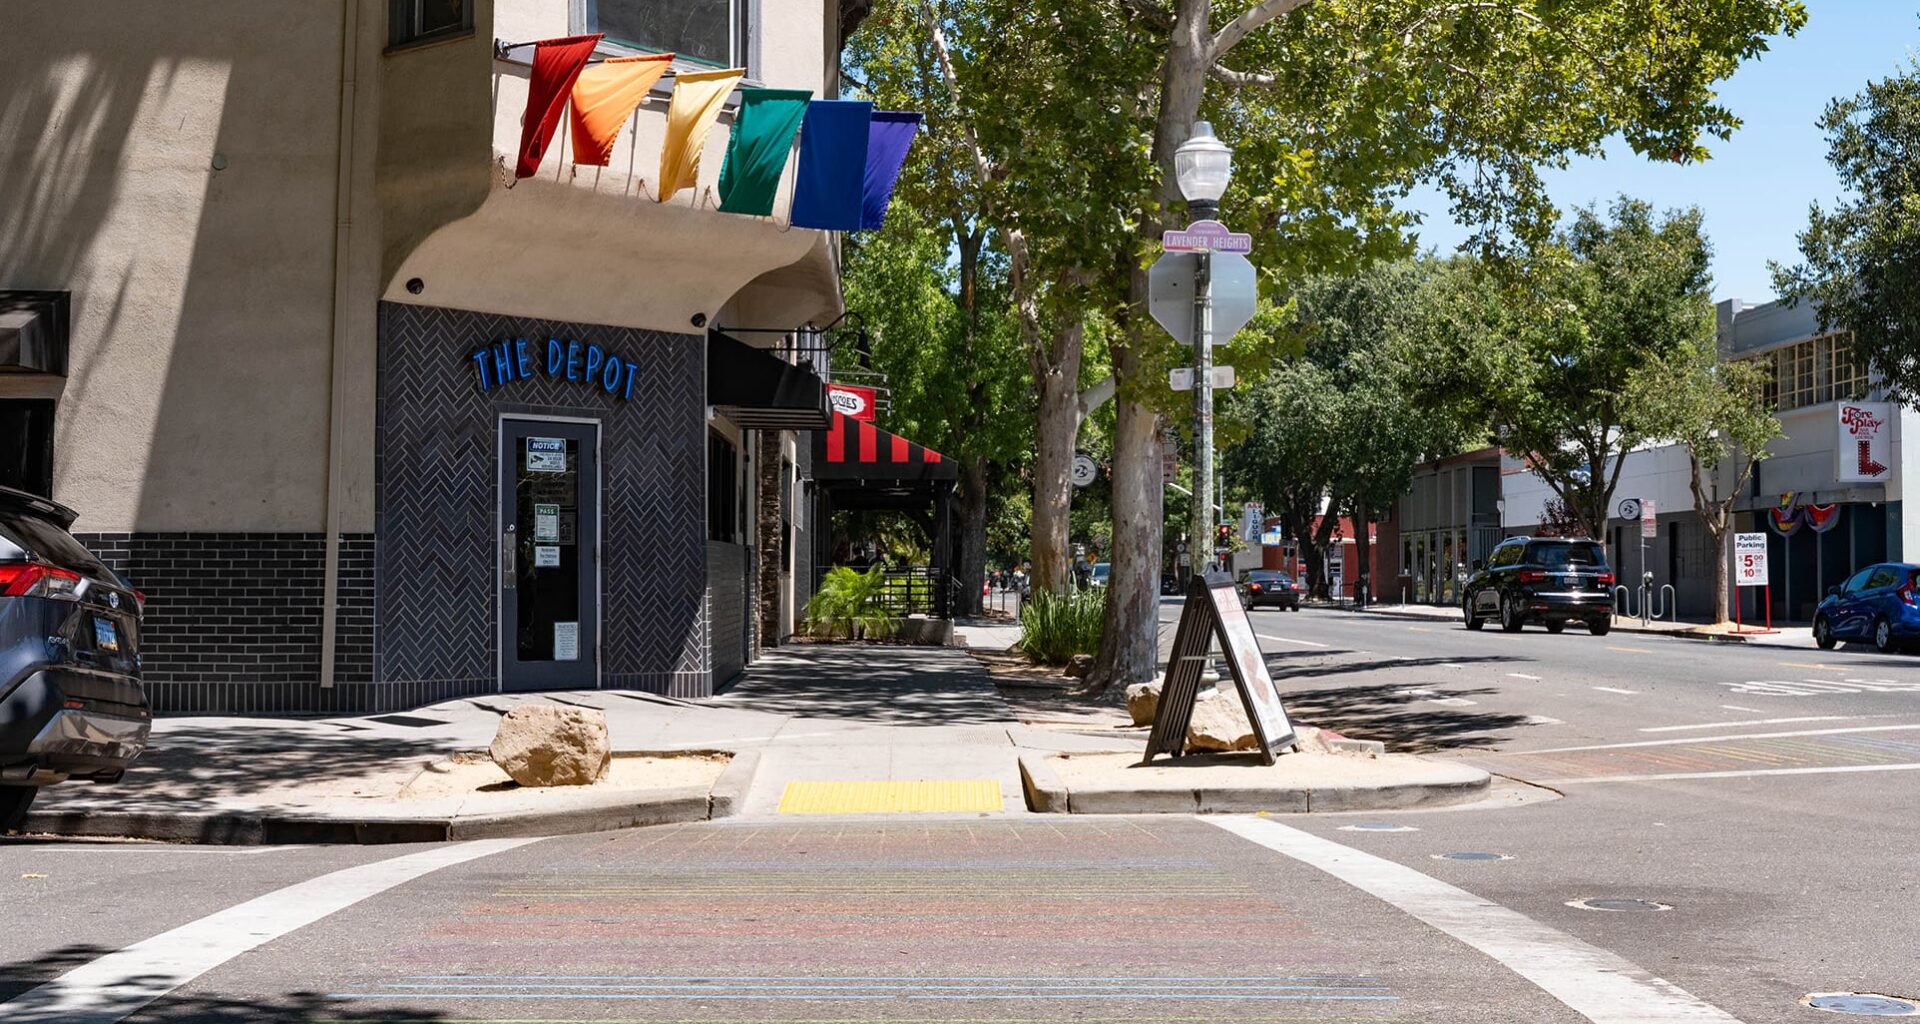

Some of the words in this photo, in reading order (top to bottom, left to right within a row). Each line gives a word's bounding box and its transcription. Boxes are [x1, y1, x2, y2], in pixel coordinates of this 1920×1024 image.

[1166, 235, 1208, 247] LAVENDER
[1212, 237, 1249, 250] HEIGHTS
[474, 338, 532, 392] THE
[548, 338, 639, 400] DEPOT
[1841, 406, 1873, 425] Fore
[1850, 418, 1882, 434] Play
[532, 442, 561, 450] NOTICE
